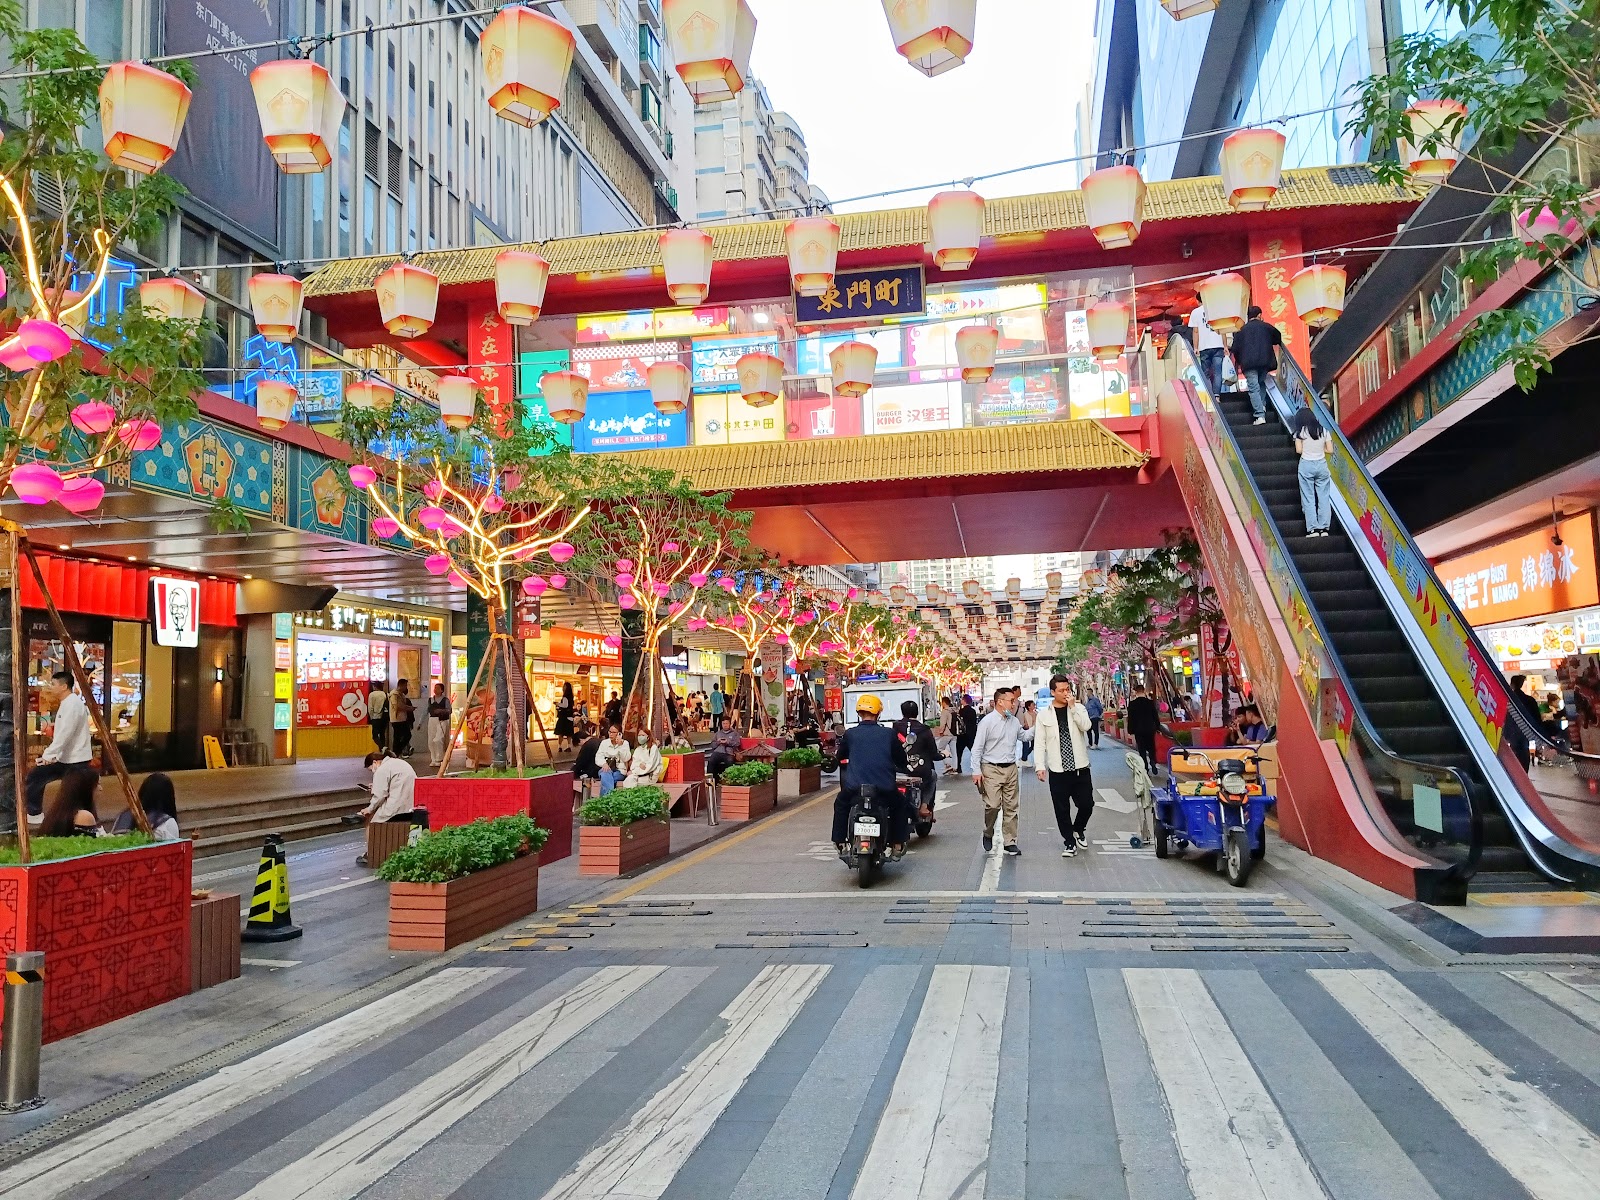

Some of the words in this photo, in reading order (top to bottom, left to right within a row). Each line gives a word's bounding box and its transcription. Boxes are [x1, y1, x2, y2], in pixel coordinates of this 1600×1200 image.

[876, 416, 902, 425] KING
[907, 407, 950, 423] 汉堡王
[1520, 544, 1580, 593] 绵绵冰
[1492, 581, 1519, 605] MANGO
[32, 622, 49, 632] KFC
[523, 627, 536, 637] 5F
[1476, 680, 1498, 718] 2F
